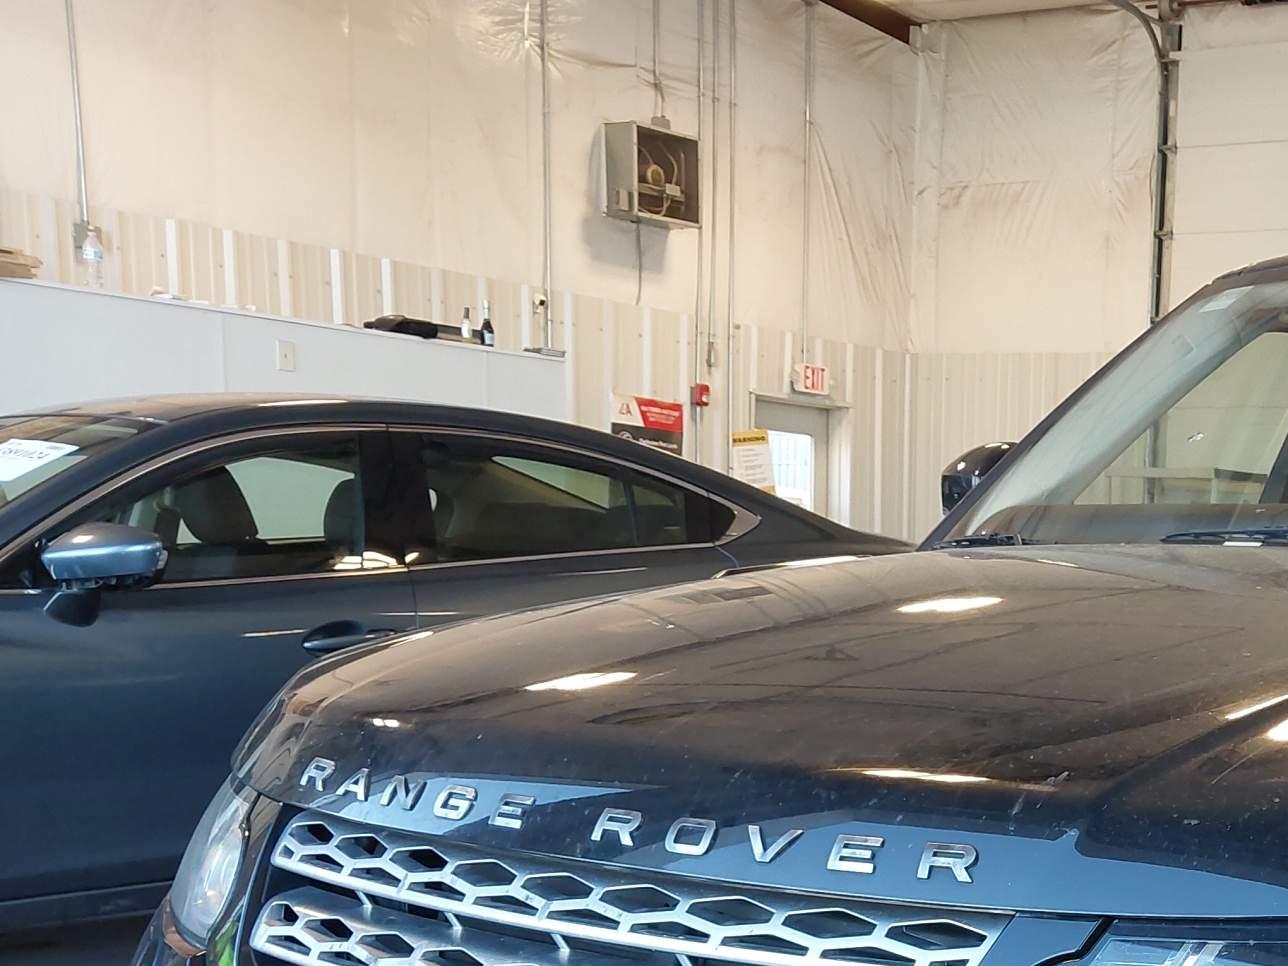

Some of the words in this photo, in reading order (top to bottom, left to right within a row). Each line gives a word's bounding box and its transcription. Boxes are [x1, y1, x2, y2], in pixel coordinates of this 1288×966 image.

[804, 365, 825, 392] EXIT
[299, 756, 536, 830] RANGE
[590, 807, 979, 884] ROVER
